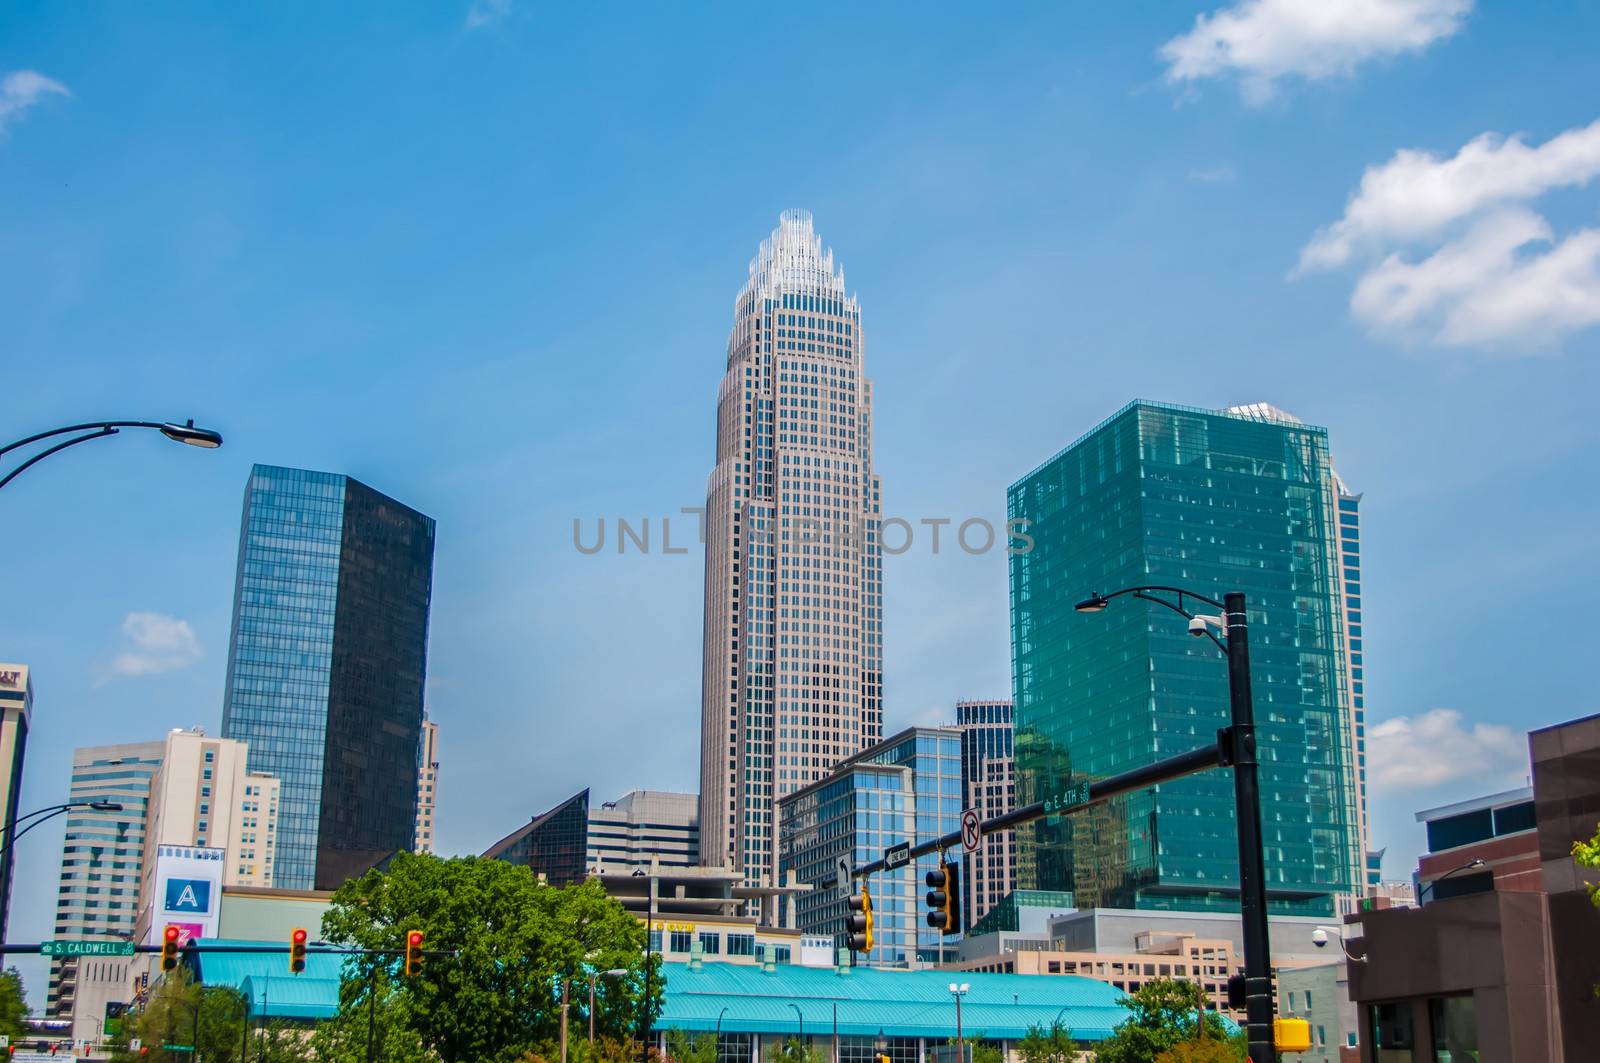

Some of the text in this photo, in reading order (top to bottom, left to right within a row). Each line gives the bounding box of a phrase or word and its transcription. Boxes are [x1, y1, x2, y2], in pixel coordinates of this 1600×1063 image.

[1063, 789, 1076, 805] 4TH
[176, 885, 198, 907] A
[56, 943, 117, 954] S. CALDWELL
